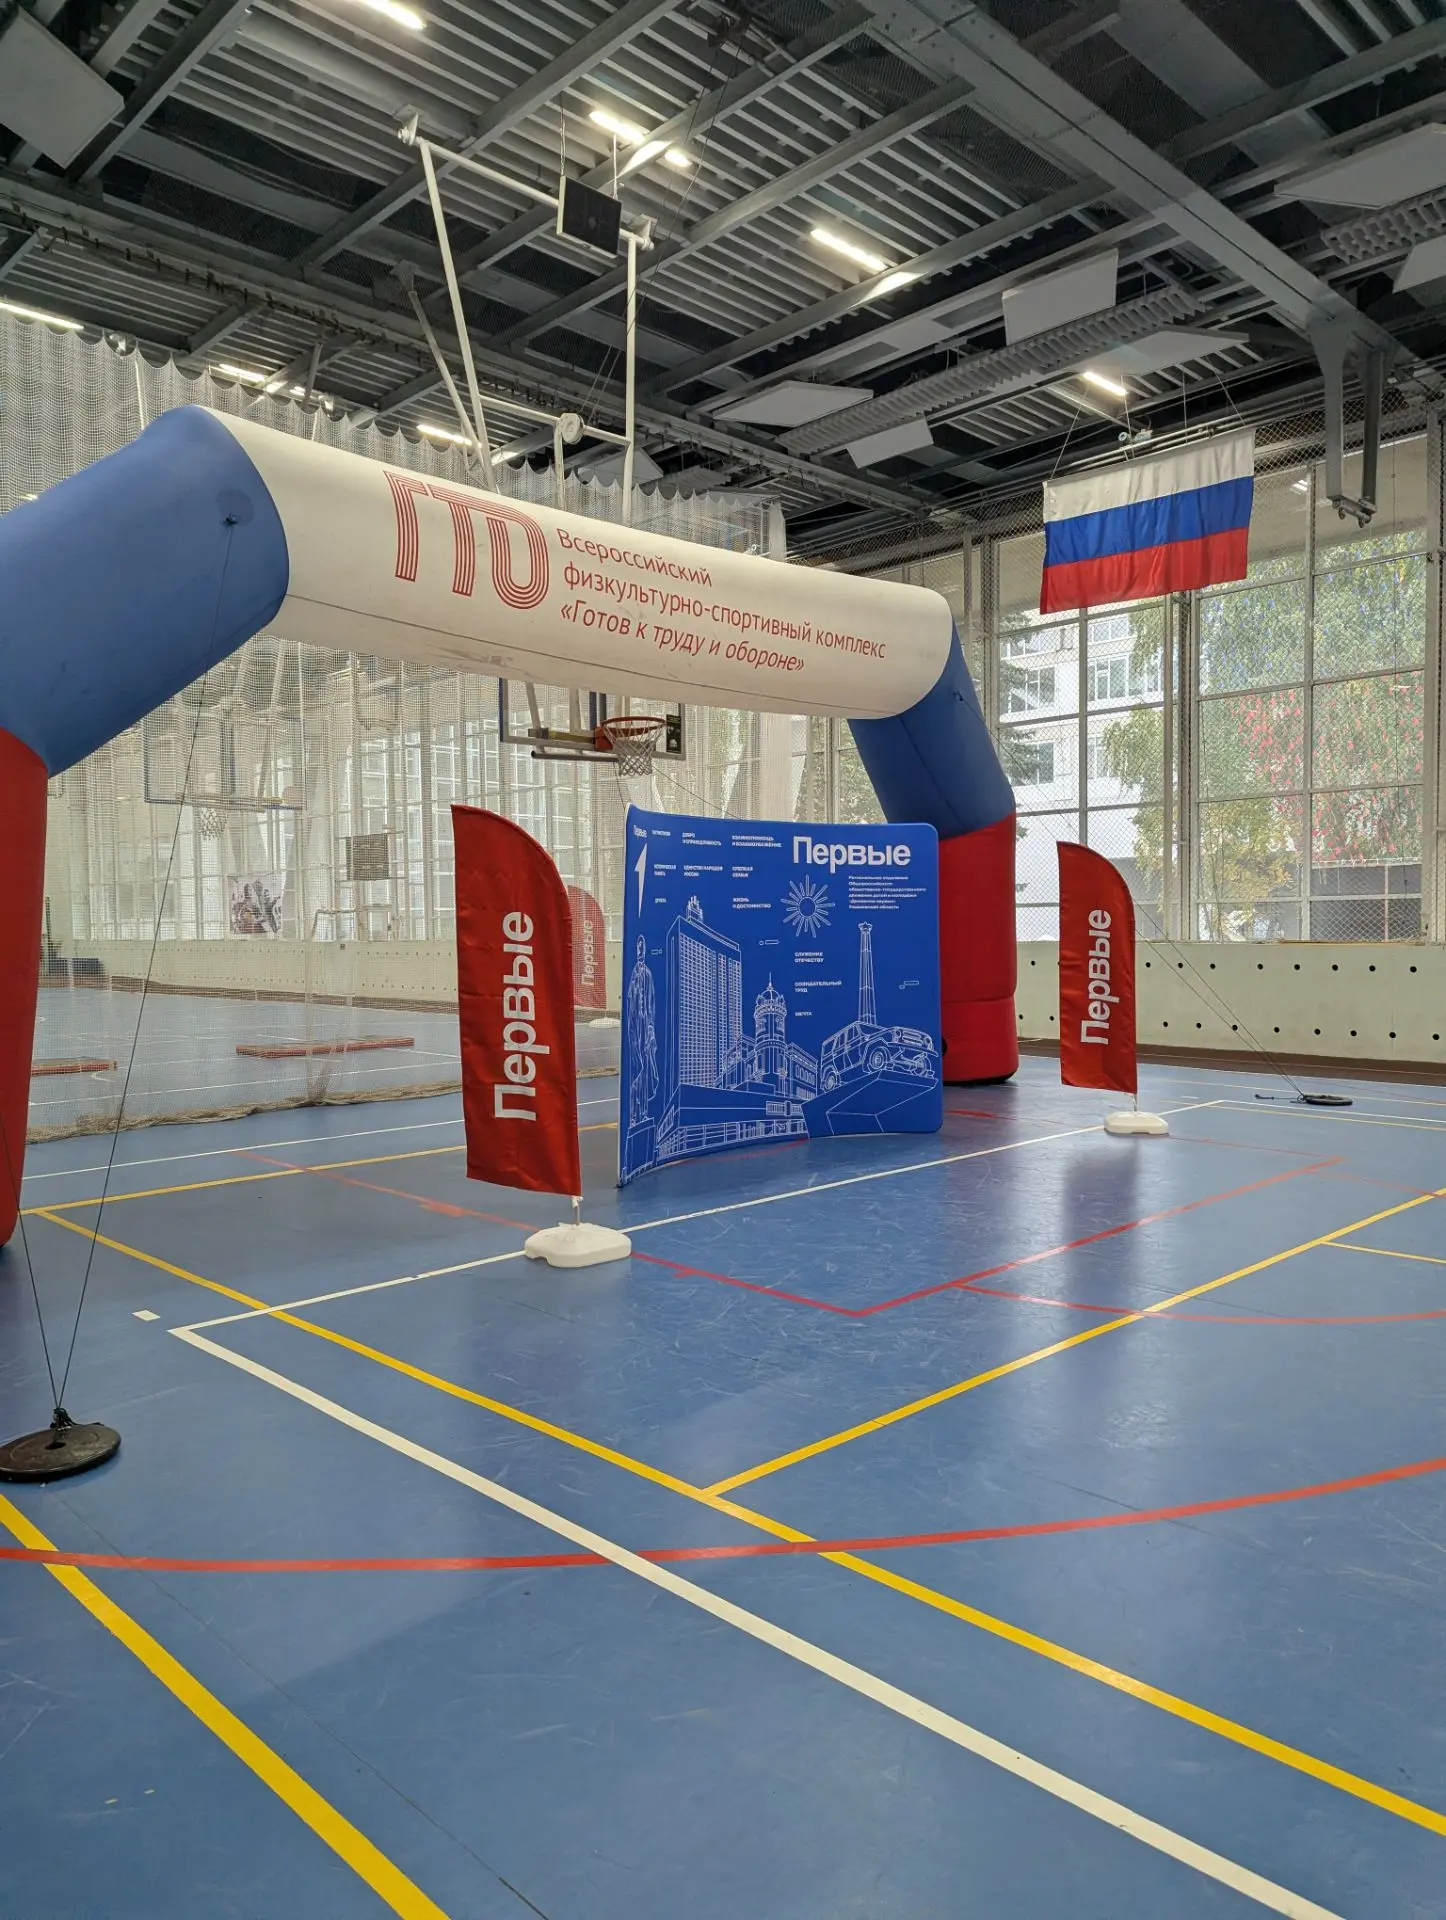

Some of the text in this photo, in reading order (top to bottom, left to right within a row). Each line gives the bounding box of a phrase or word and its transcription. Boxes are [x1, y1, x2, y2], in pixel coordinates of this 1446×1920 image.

[385, 471, 550, 610] ГТО
[556, 528, 712, 587] Всероссийский
[560, 599, 805, 671] «Готов к труду и обороне»
[564, 561, 886, 659] физкультурно-спортивный комплекс
[793, 836, 911, 873] Первые
[581, 920, 598, 985] Первые
[1080, 909, 1120, 1045] Первые
[495, 911, 550, 1121] Первые
